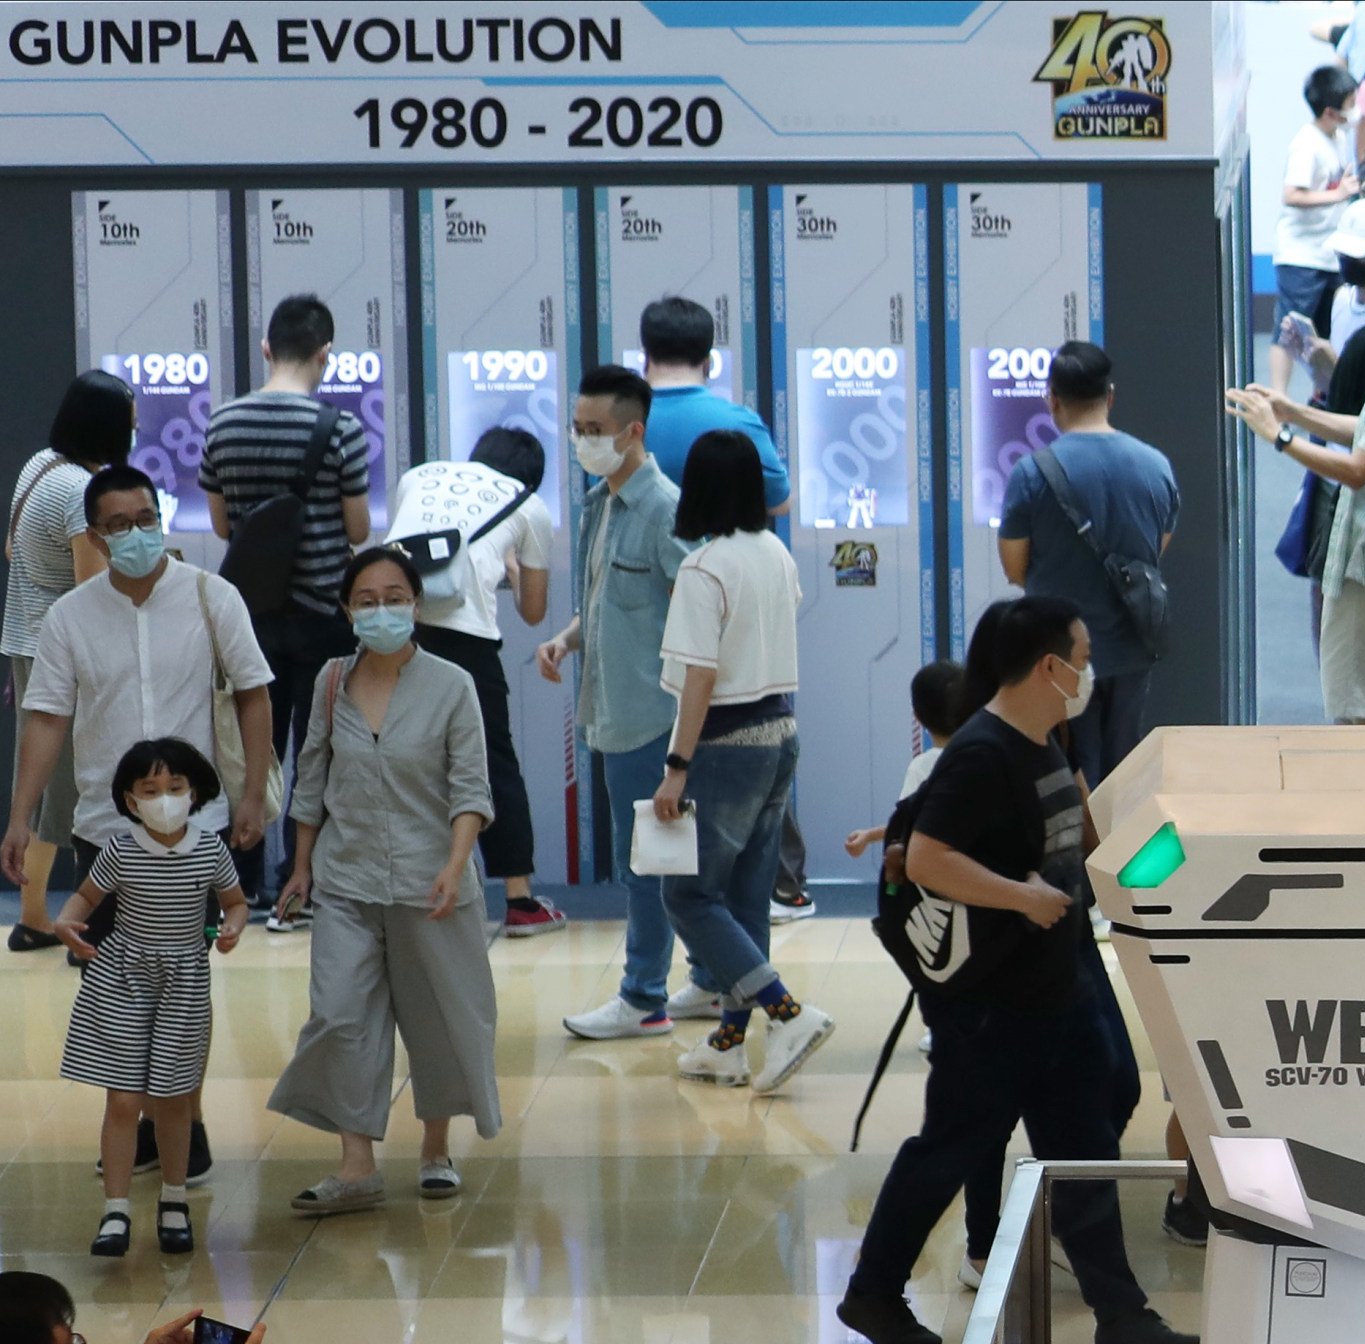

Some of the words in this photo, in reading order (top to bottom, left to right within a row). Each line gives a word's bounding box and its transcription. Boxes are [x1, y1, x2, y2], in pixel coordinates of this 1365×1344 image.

[9, 20, 258, 65] GUNPLA
[278, 18, 621, 63] EVOLUTION
[1069, 104, 1151, 115] ANNIVERSARY
[354, 98, 507, 149] 1980
[568, 97, 723, 148] 2020
[1057, 116, 1159, 136] GUNPLA
[100, 223, 140, 238] 10th
[274, 222, 314, 238] 10th
[446, 220, 486, 236] 20th
[622, 218, 662, 234] 20th
[797, 217, 837, 233] 30th
[971, 215, 1011, 231] 30th
[124, 353, 209, 386] 1980
[462, 351, 548, 381] 1990
[811, 347, 898, 379] 2000
[1265, 1067, 1348, 1087] SCV-70
